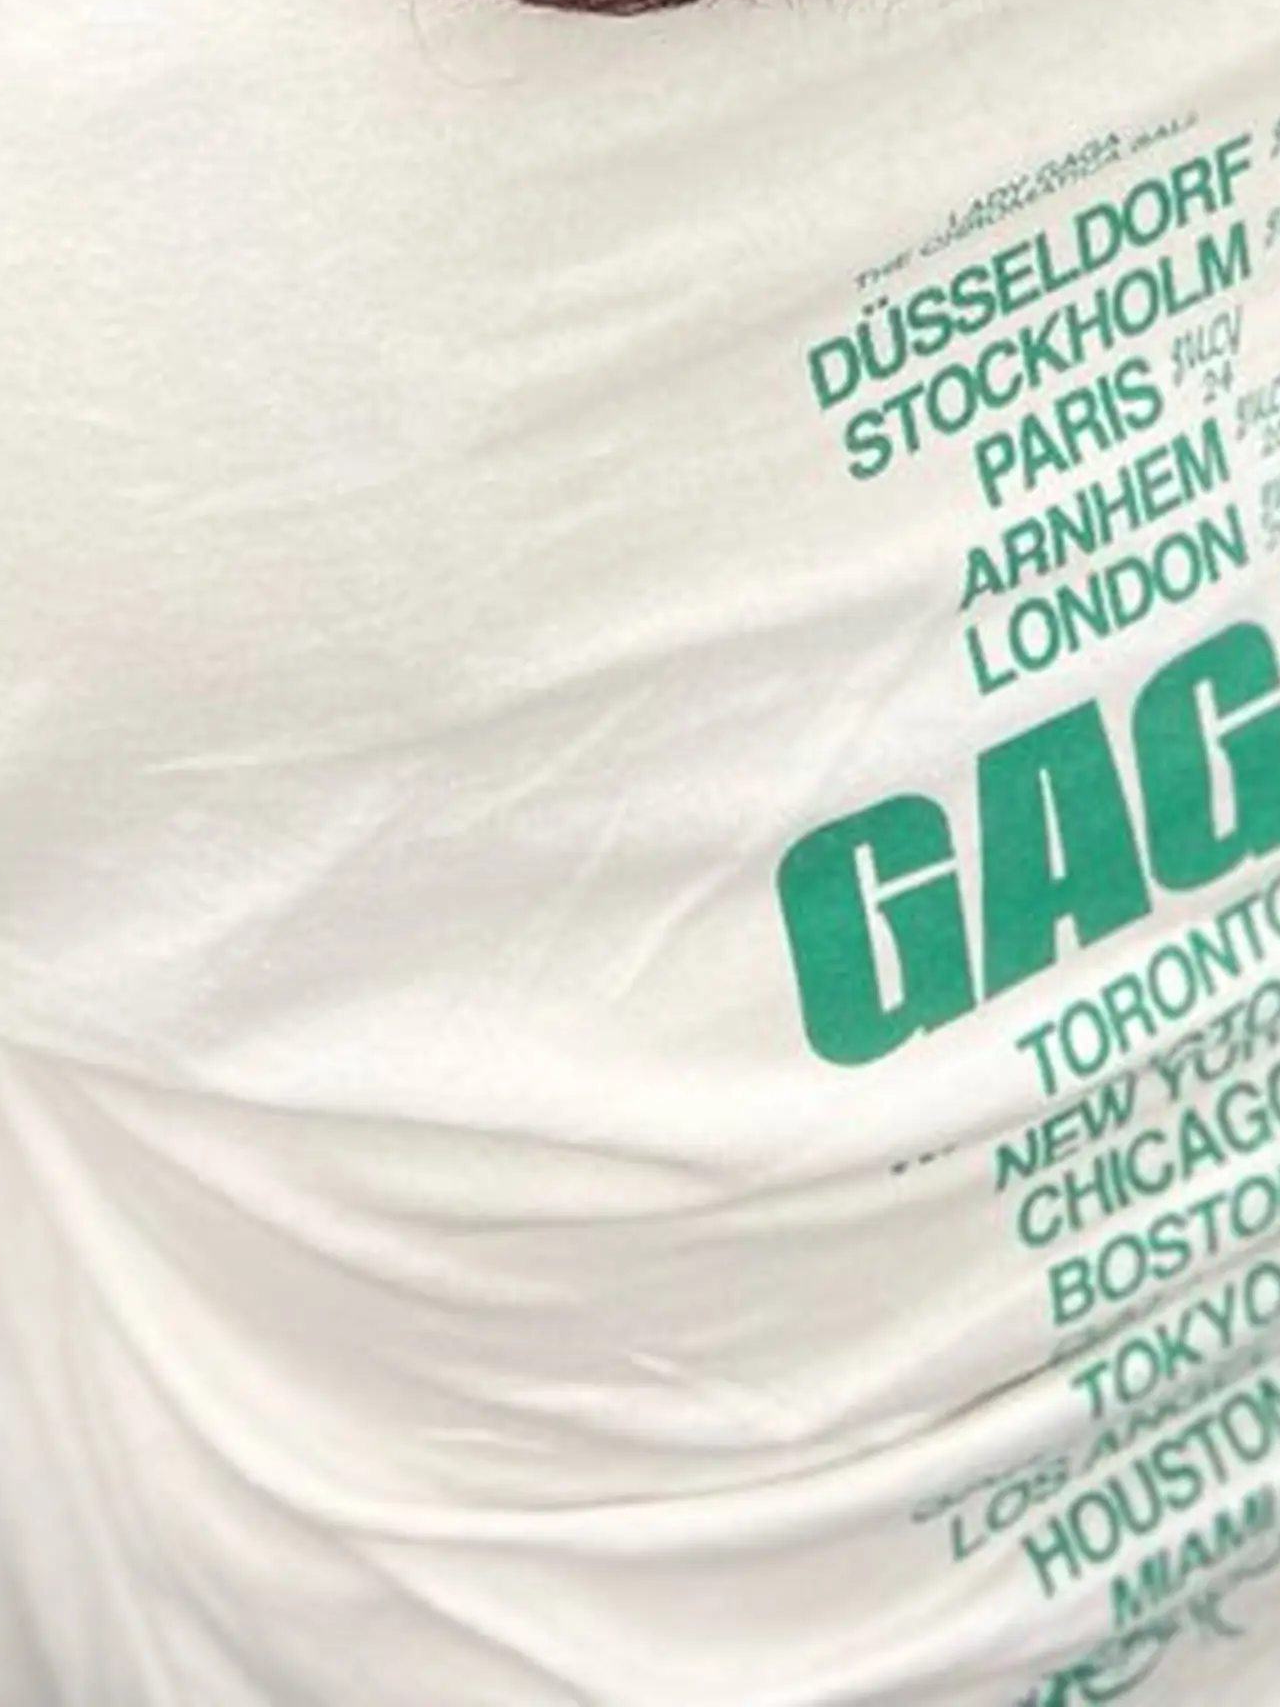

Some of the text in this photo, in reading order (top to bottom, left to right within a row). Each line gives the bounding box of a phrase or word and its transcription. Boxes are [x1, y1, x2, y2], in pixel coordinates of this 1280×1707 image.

[807, 133, 1253, 410] DÜSSELDORF
[843, 219, 1252, 481] STOCKHOLM
[959, 417, 1232, 611] ARNHEM
[973, 356, 1165, 509] PARIS
[963, 502, 1249, 697] LONDON
[993, 1071, 1137, 1194] NEW
